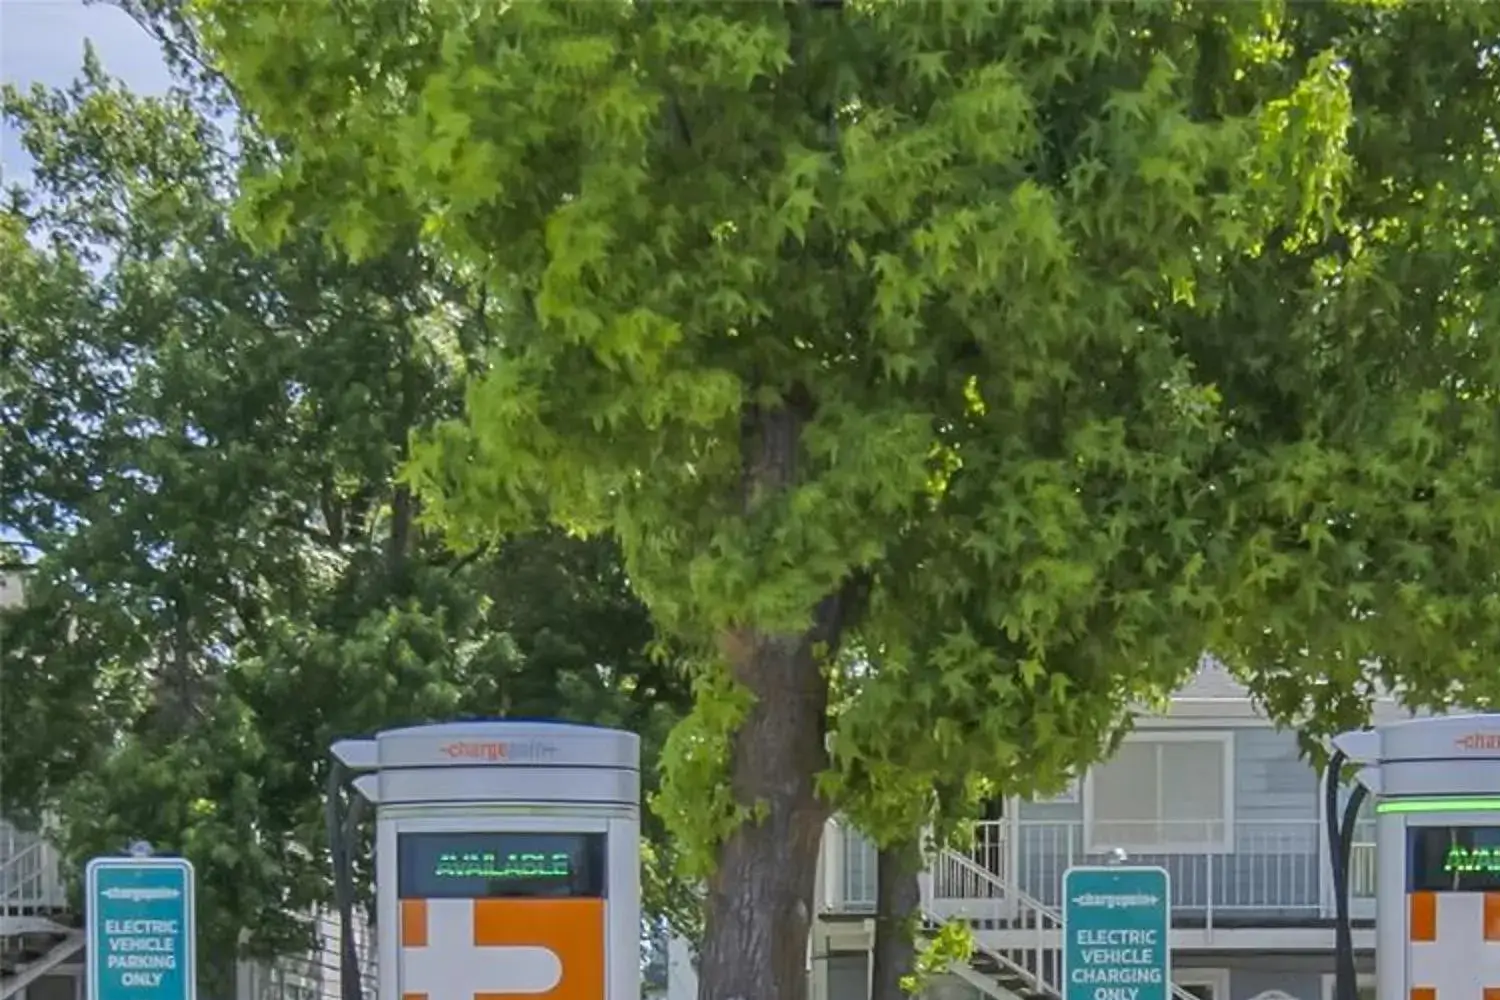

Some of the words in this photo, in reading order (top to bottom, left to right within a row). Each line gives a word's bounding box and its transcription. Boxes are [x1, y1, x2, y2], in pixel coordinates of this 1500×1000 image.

[106, 920, 178, 934] ELECTRIC
[1077, 930, 1157, 944] ELECTRIC
[109, 938, 174, 951] VEHICLE
[108, 956, 175, 968] PARKING
[1082, 949, 1152, 964] VEHICLE
[121, 972, 163, 986] ONLY
[1072, 968, 1161, 982] CHARGING
